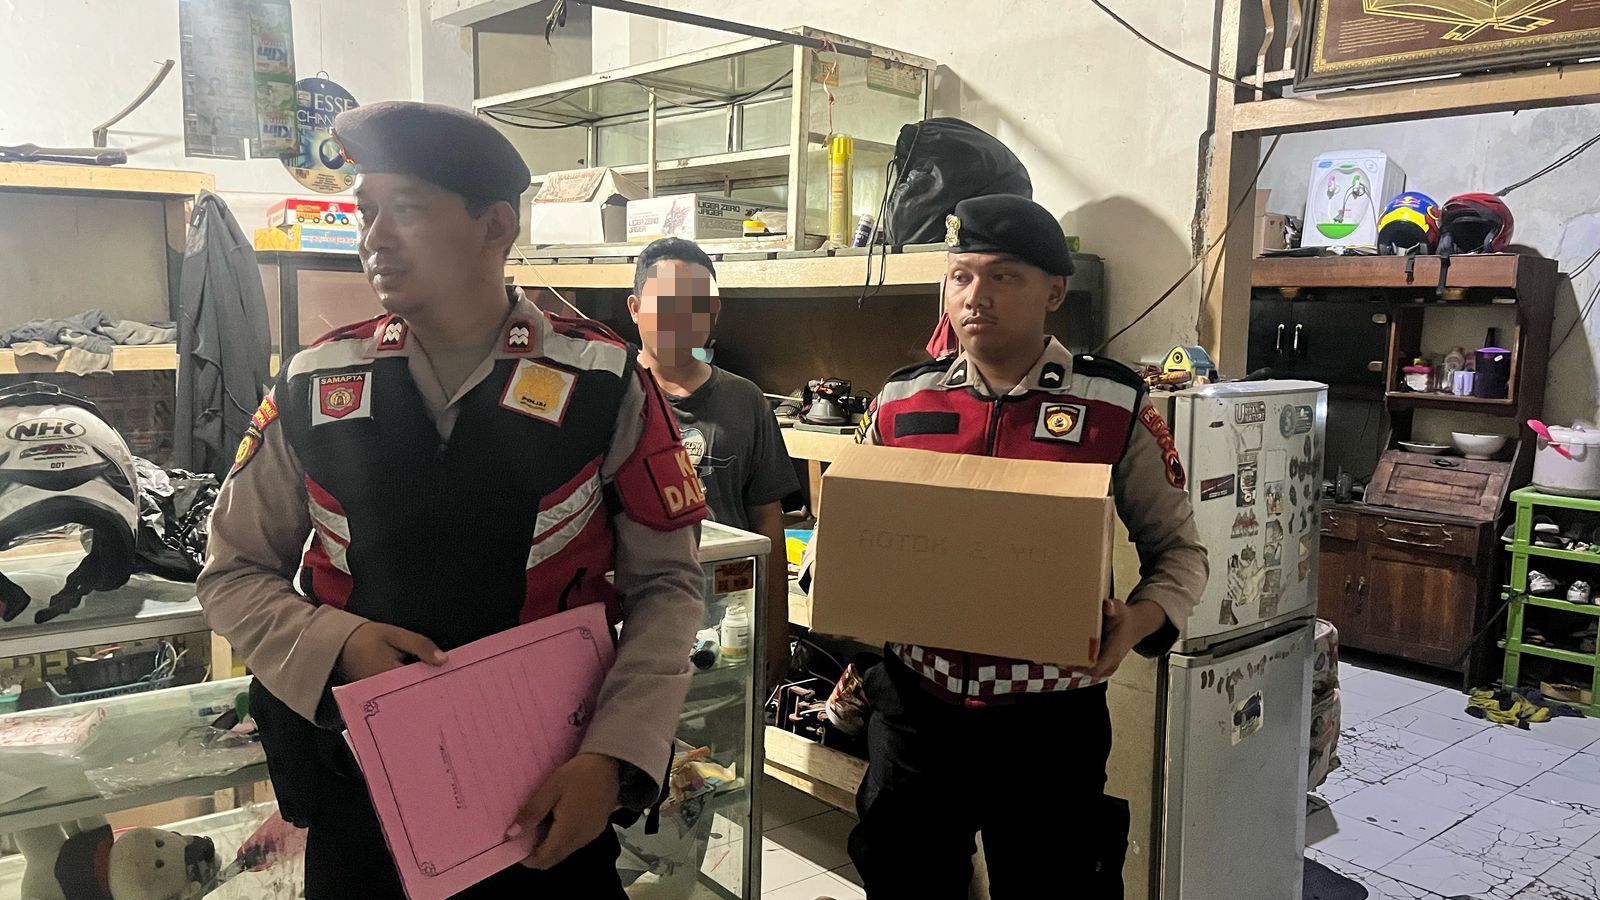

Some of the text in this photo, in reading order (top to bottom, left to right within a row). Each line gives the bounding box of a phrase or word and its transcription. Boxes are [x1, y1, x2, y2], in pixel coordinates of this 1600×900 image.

[314, 93, 354, 113] ESSE
[698, 202, 741, 212] LIGER ZERO
[698, 208, 723, 216] JAGER
[628, 216, 659, 227] LIGER ZERO
[628, 225, 647, 233] JAGER
[321, 375, 363, 385] SAMAPTA
[14, 422, 77, 440] NHK
